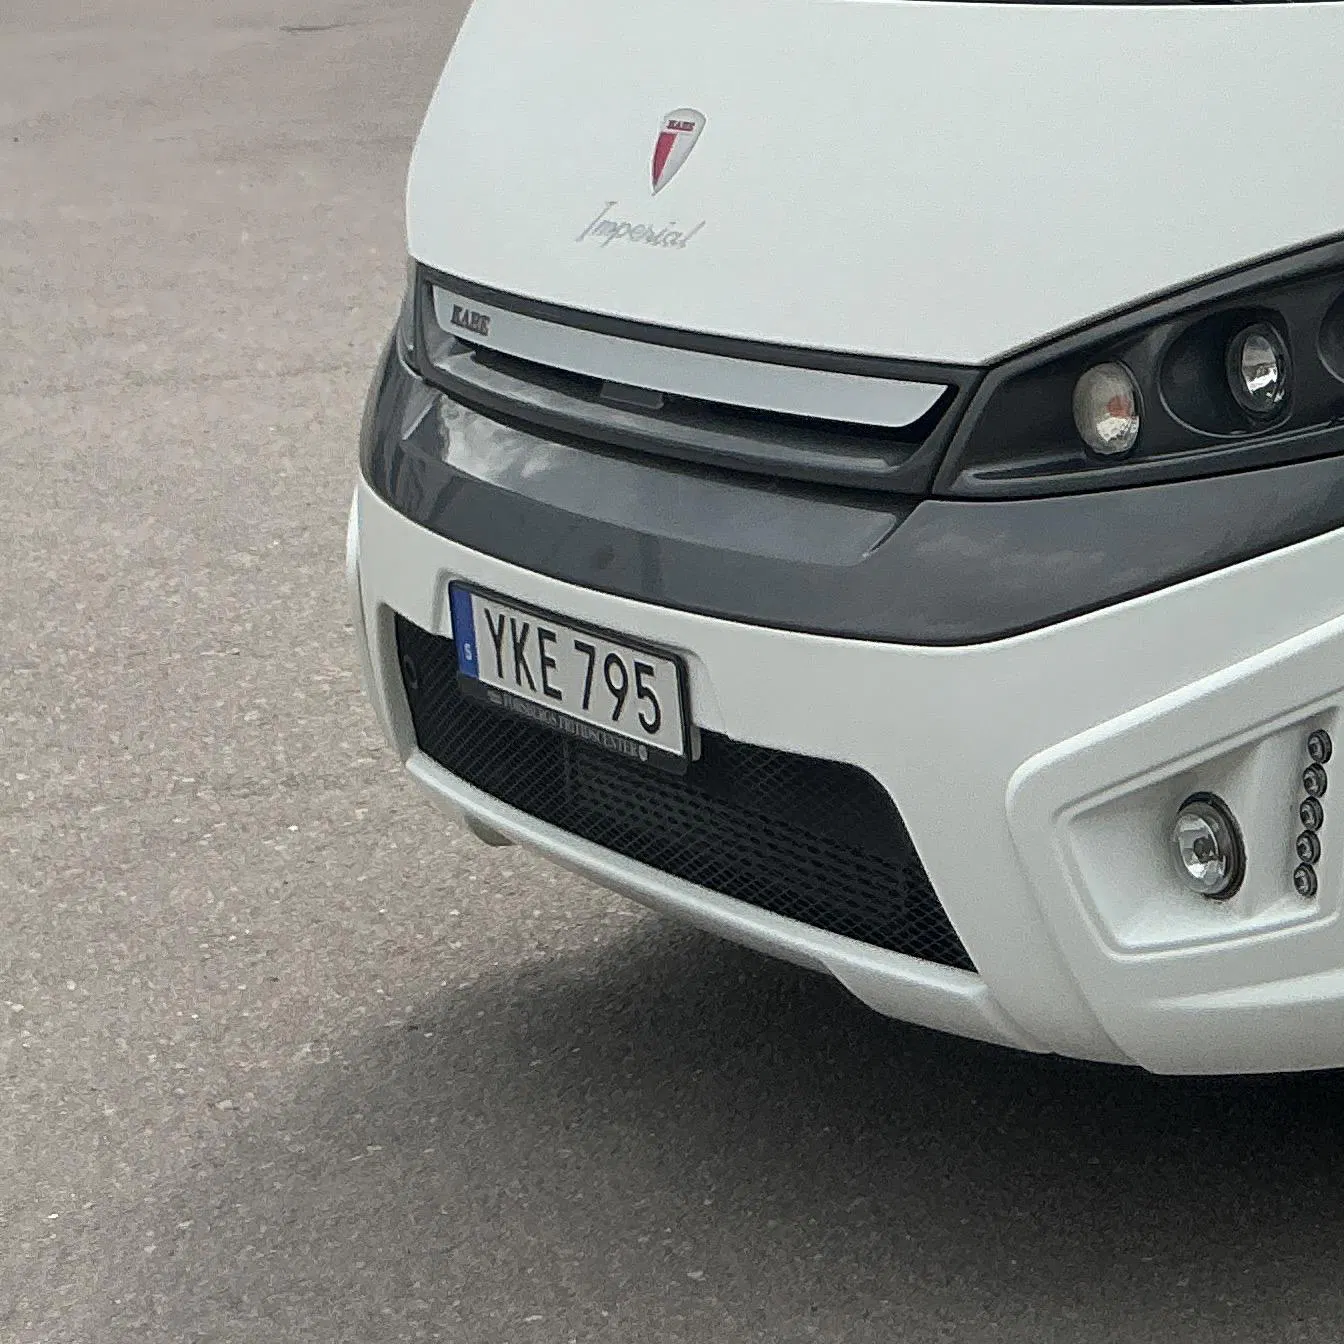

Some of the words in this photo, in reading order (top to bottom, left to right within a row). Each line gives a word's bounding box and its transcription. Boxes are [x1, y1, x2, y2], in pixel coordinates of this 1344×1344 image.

[666, 119, 696, 132] KABE
[575, 200, 706, 249] Imperial
[450, 303, 491, 337] KABE
[463, 642, 473, 660] S
[484, 607, 563, 701] YKE
[573, 639, 661, 734] 795
